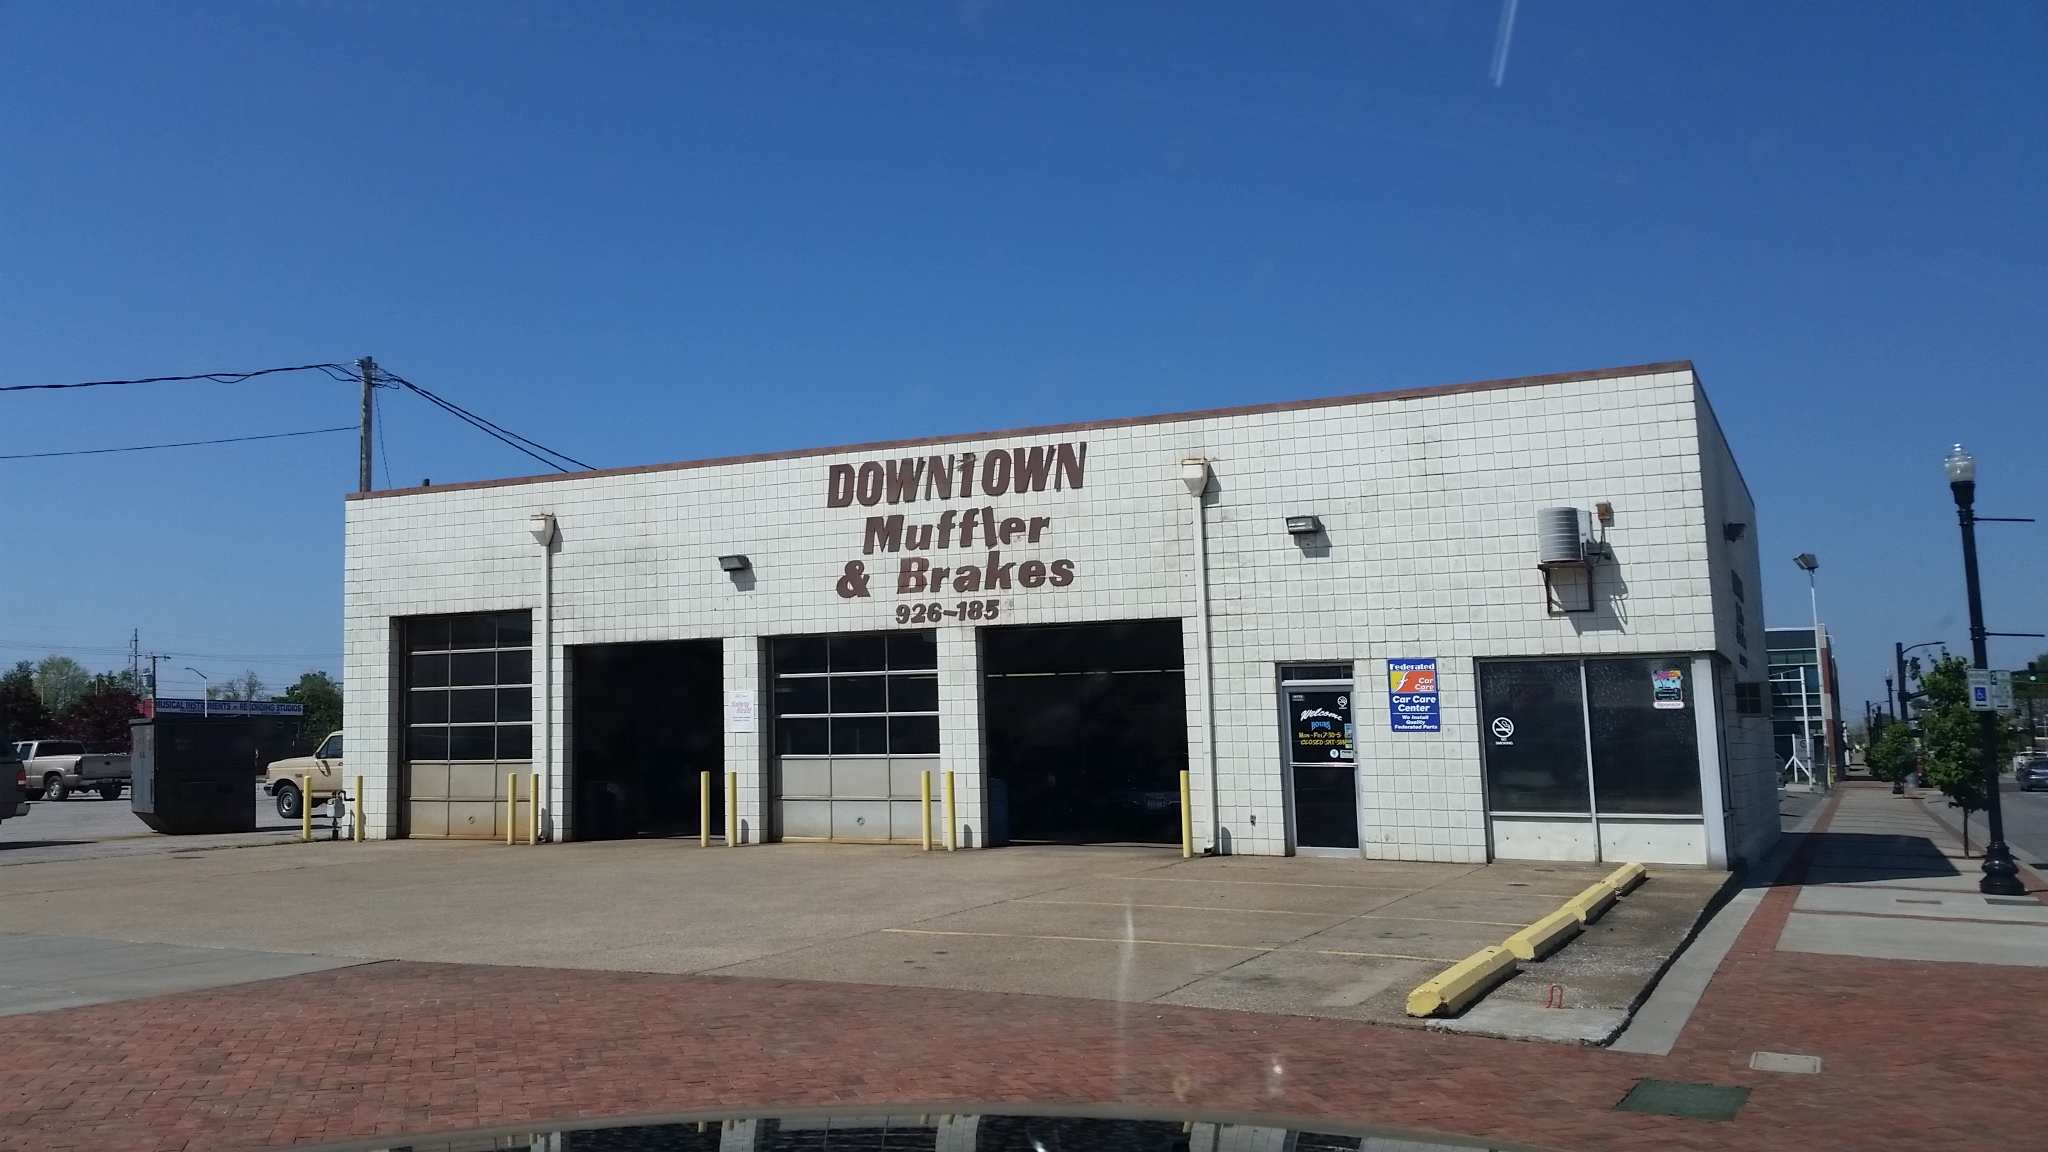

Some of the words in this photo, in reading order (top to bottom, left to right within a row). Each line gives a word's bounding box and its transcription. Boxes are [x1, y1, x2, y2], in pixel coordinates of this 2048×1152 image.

[862, 505, 1051, 555] Muffler
[836, 559, 872, 599] &
[896, 551, 1076, 595] Brakes
[1392, 696, 1411, 704] Car
[1412, 695, 1437, 704] Care
[239, 702, 274, 712] REORDING
[276, 704, 302, 713] STUDIOS
[1398, 704, 1431, 712] Center
[1300, 708, 1343, 722] Welcome
